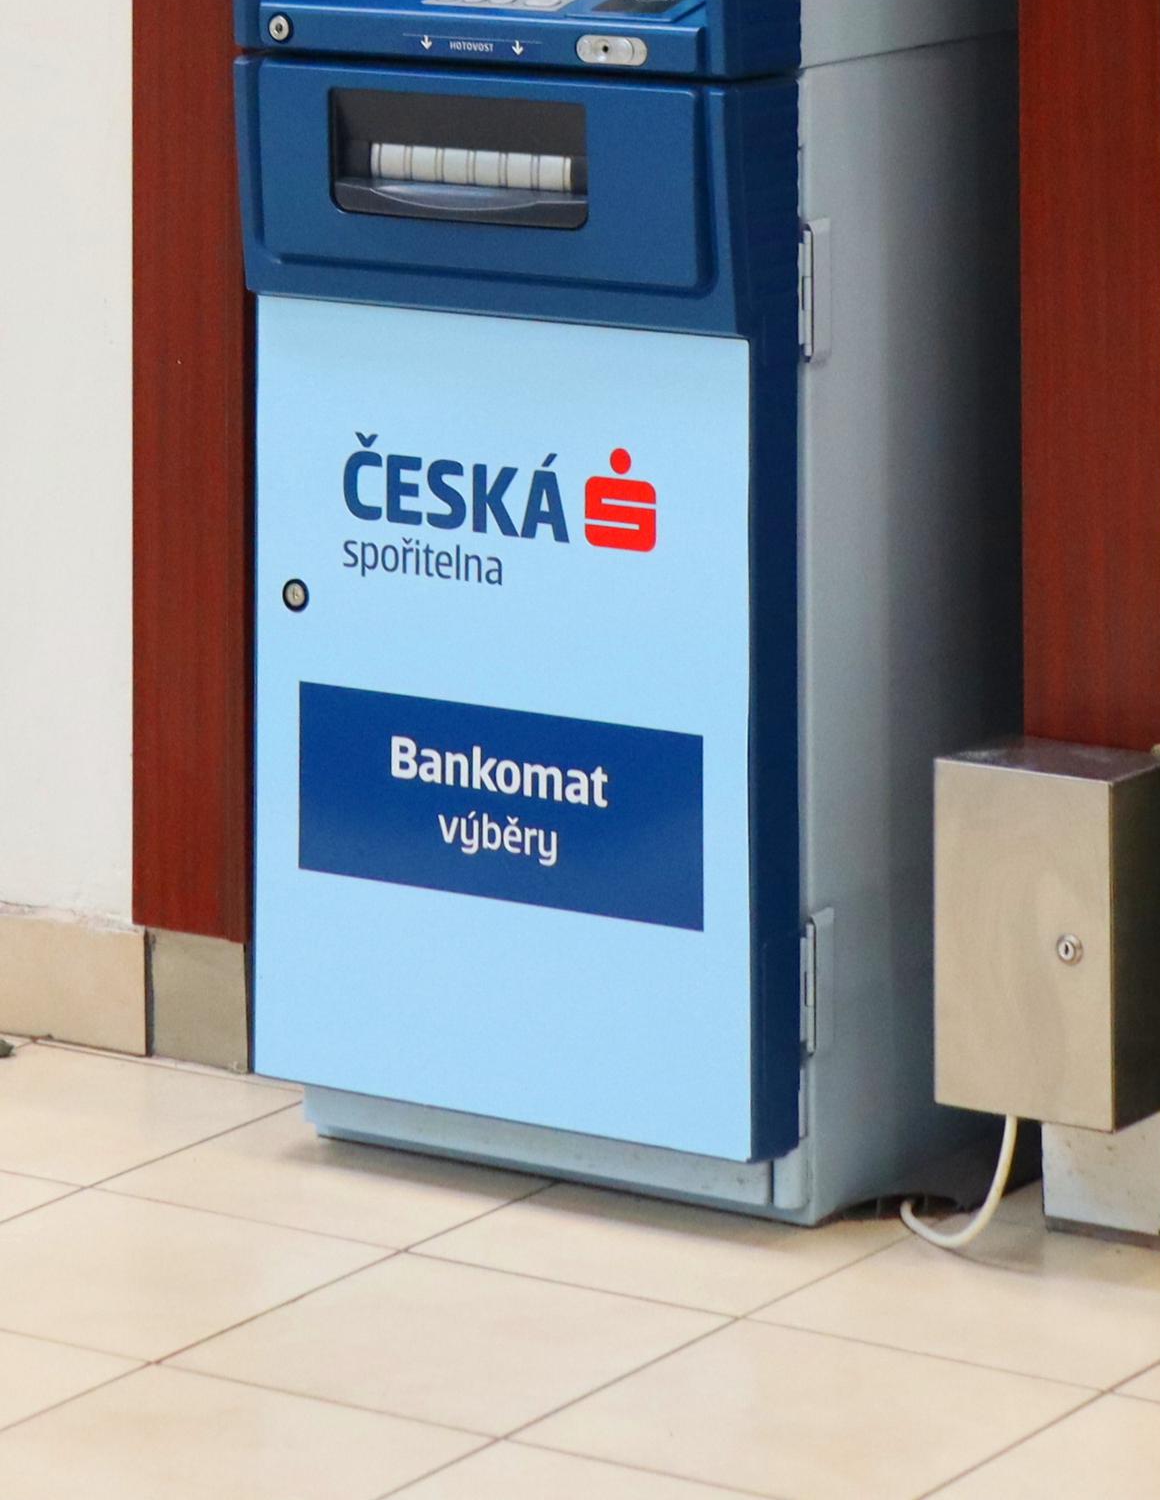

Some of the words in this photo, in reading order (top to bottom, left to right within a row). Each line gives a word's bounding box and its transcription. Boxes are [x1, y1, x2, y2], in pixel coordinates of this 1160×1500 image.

[449, 40, 494, 52] HOTOVOST
[343, 432, 570, 543] ČESKÁ
[342, 537, 503, 585] spořitelna
[390, 735, 609, 808] Bankomat
[438, 811, 558, 865] výběry
